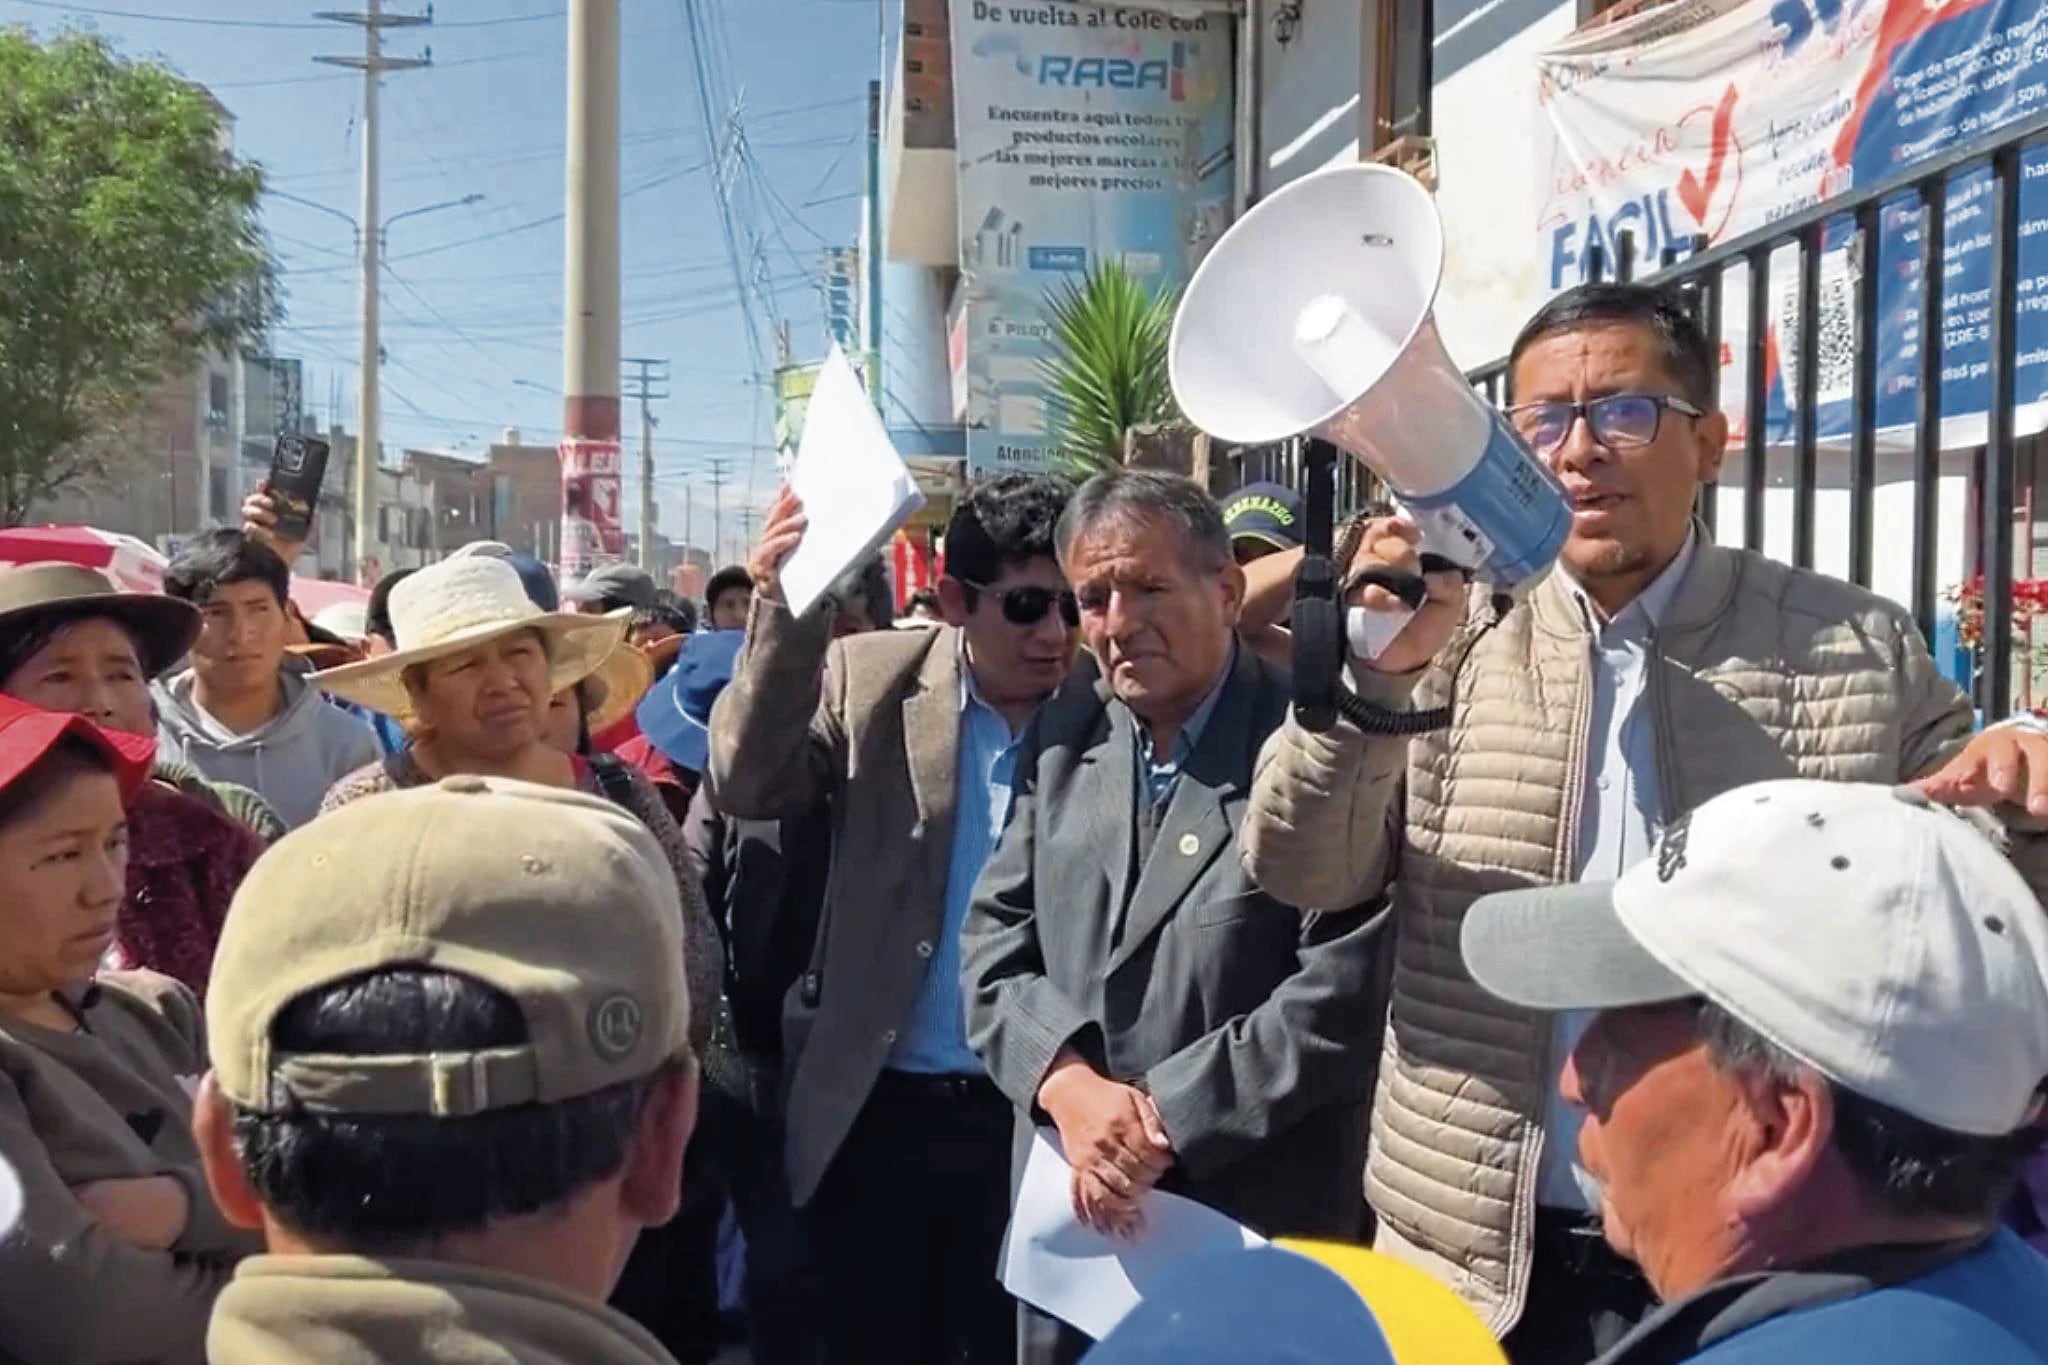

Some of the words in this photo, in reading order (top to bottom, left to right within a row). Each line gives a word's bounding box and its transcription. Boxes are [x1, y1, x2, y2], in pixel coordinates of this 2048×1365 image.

[973, 1, 1001, 22] De
[1009, 5, 1078, 27] vuelta
[1087, 9, 1106, 28] al
[1114, 9, 1161, 30] Cole
[988, 104, 1080, 122] Encuentra
[1125, 113, 1171, 127] todos
[1013, 130, 1101, 145] productos
[1103, 134, 1181, 147] escolares
[1024, 152, 1092, 168] mejores
[1097, 157, 1157, 168] marcas
[1029, 174, 1098, 190] mejores
